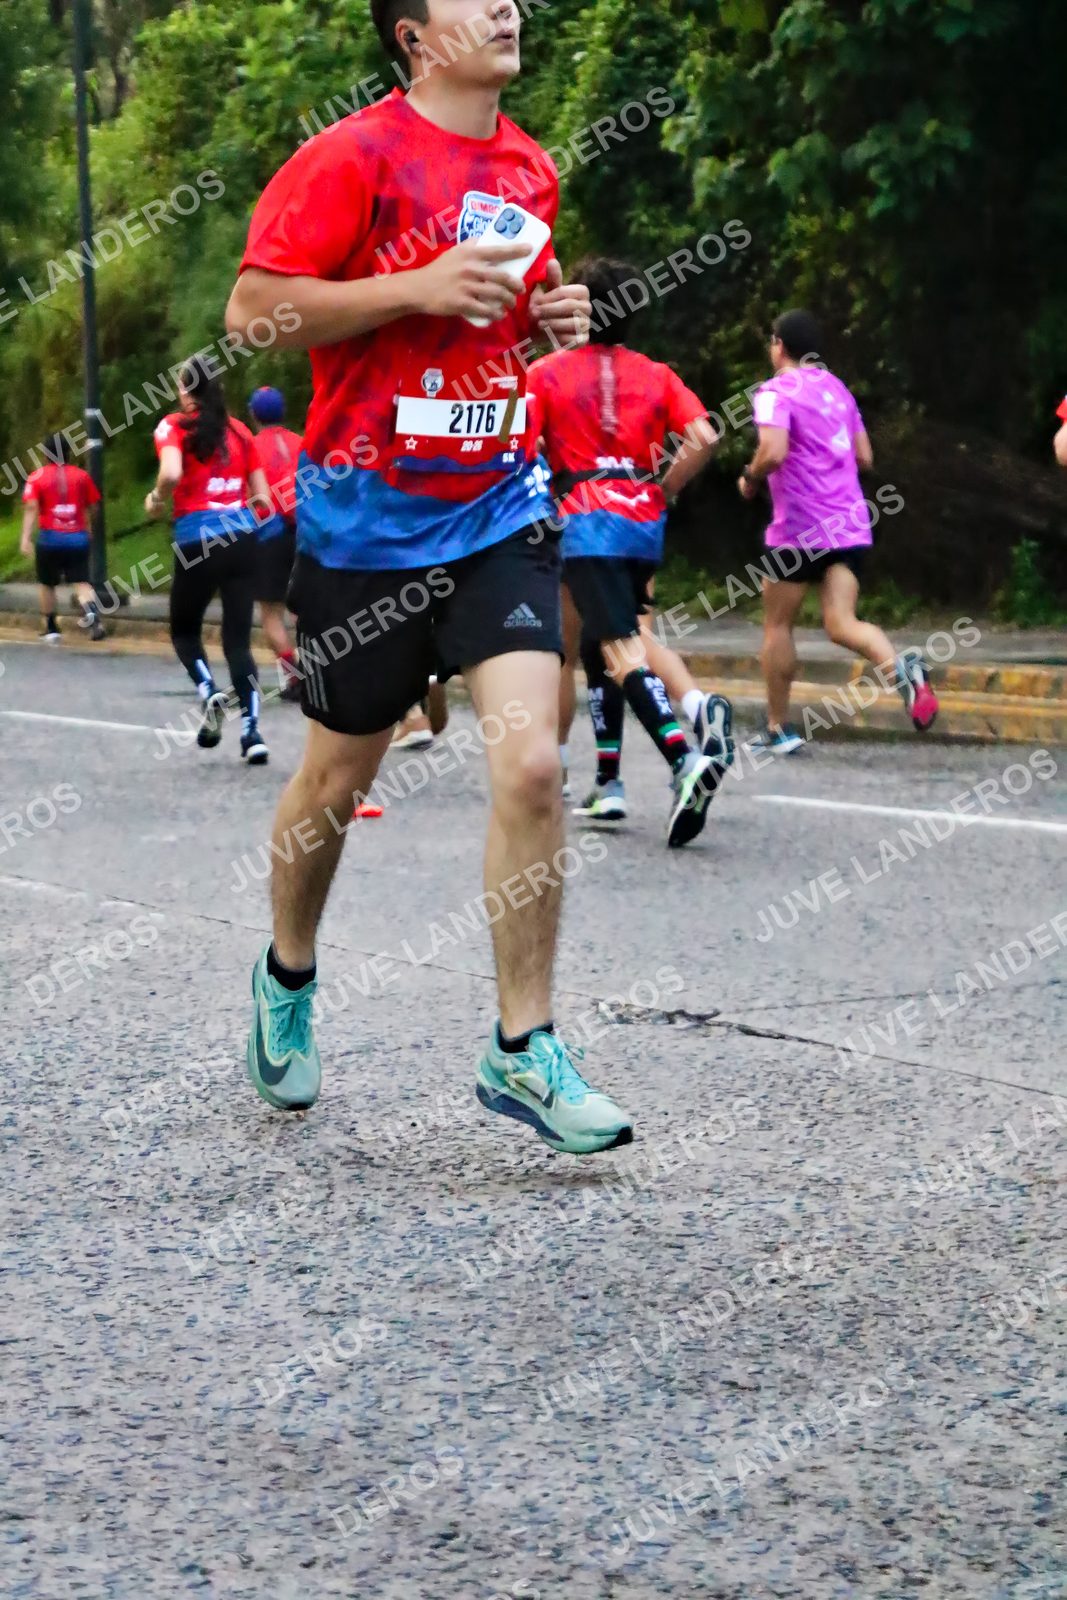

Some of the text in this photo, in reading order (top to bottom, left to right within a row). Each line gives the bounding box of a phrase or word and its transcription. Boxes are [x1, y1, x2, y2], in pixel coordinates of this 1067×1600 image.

[448, 402, 497, 434] 2176
[503, 614, 543, 628] adidas
[588, 686, 607, 731] MEX
[643, 675, 674, 716] MEX
